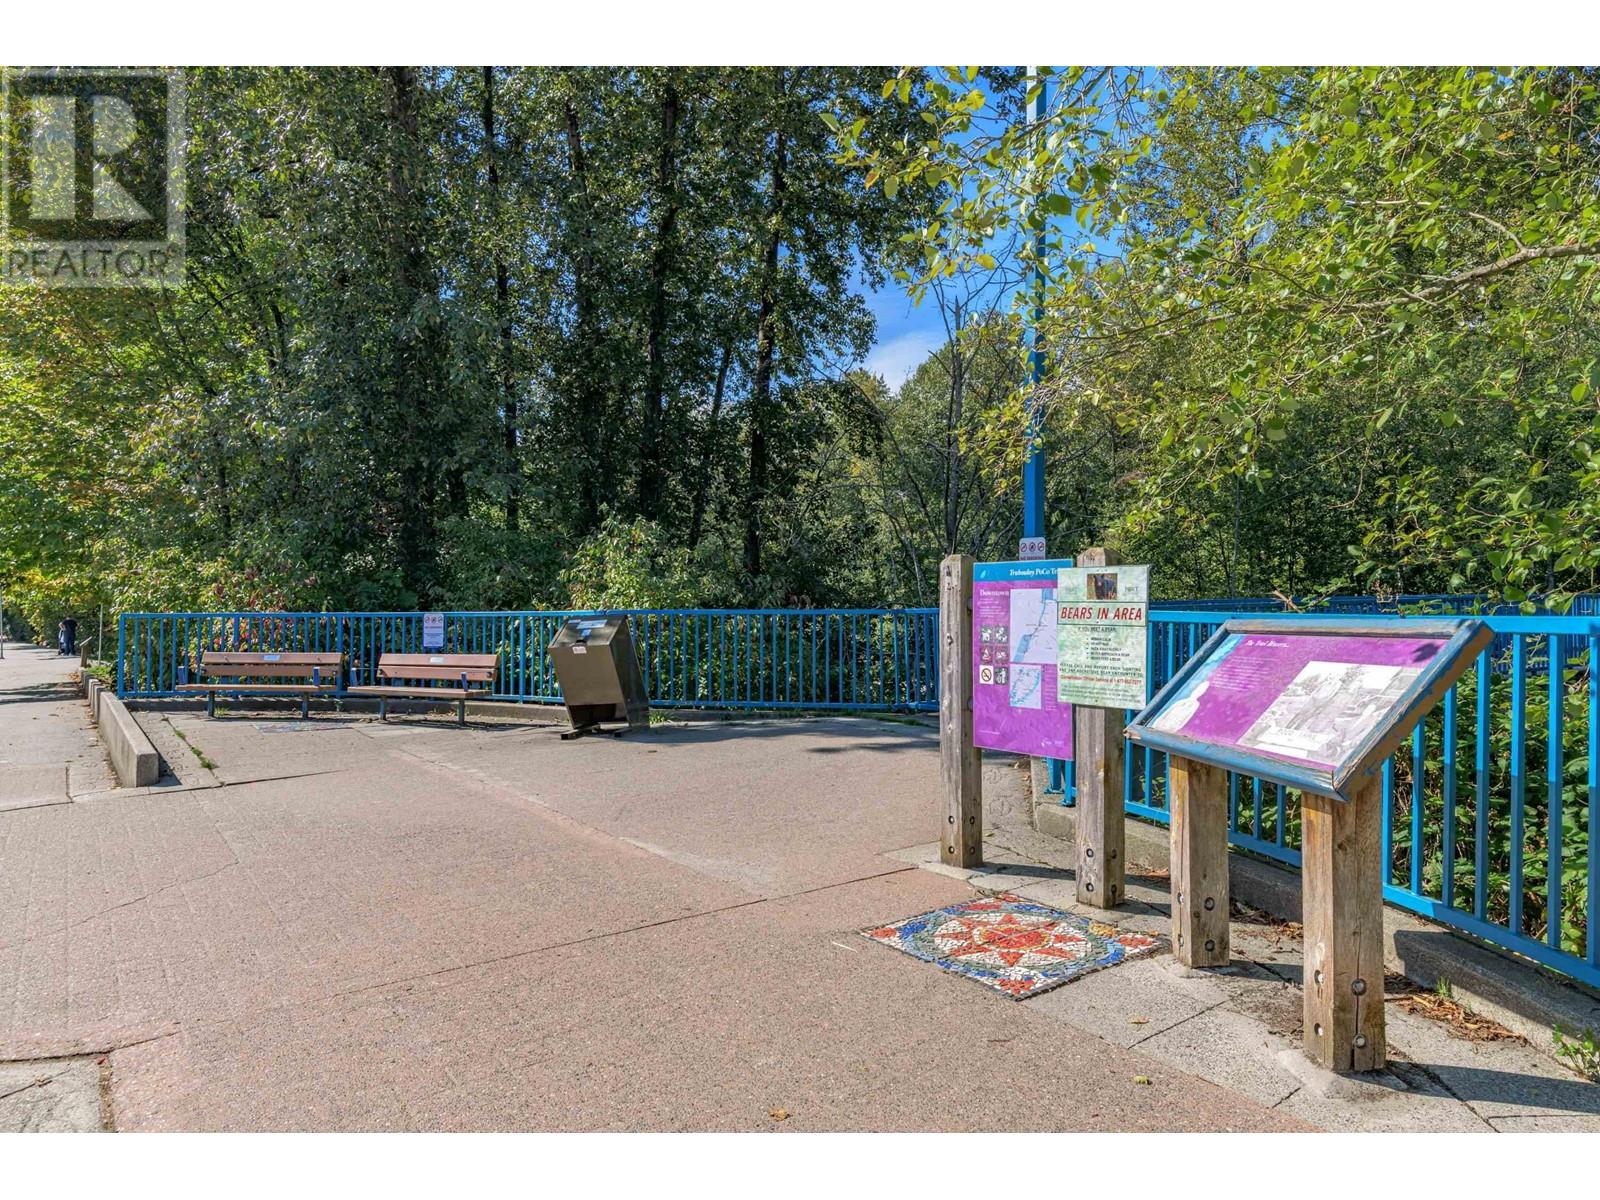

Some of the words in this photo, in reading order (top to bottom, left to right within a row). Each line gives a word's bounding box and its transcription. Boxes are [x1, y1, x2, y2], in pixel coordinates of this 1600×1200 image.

[1061, 607, 1093, 619] BEARS
[1097, 607, 1109, 620] IN
[1113, 607, 1142, 620] AREA
